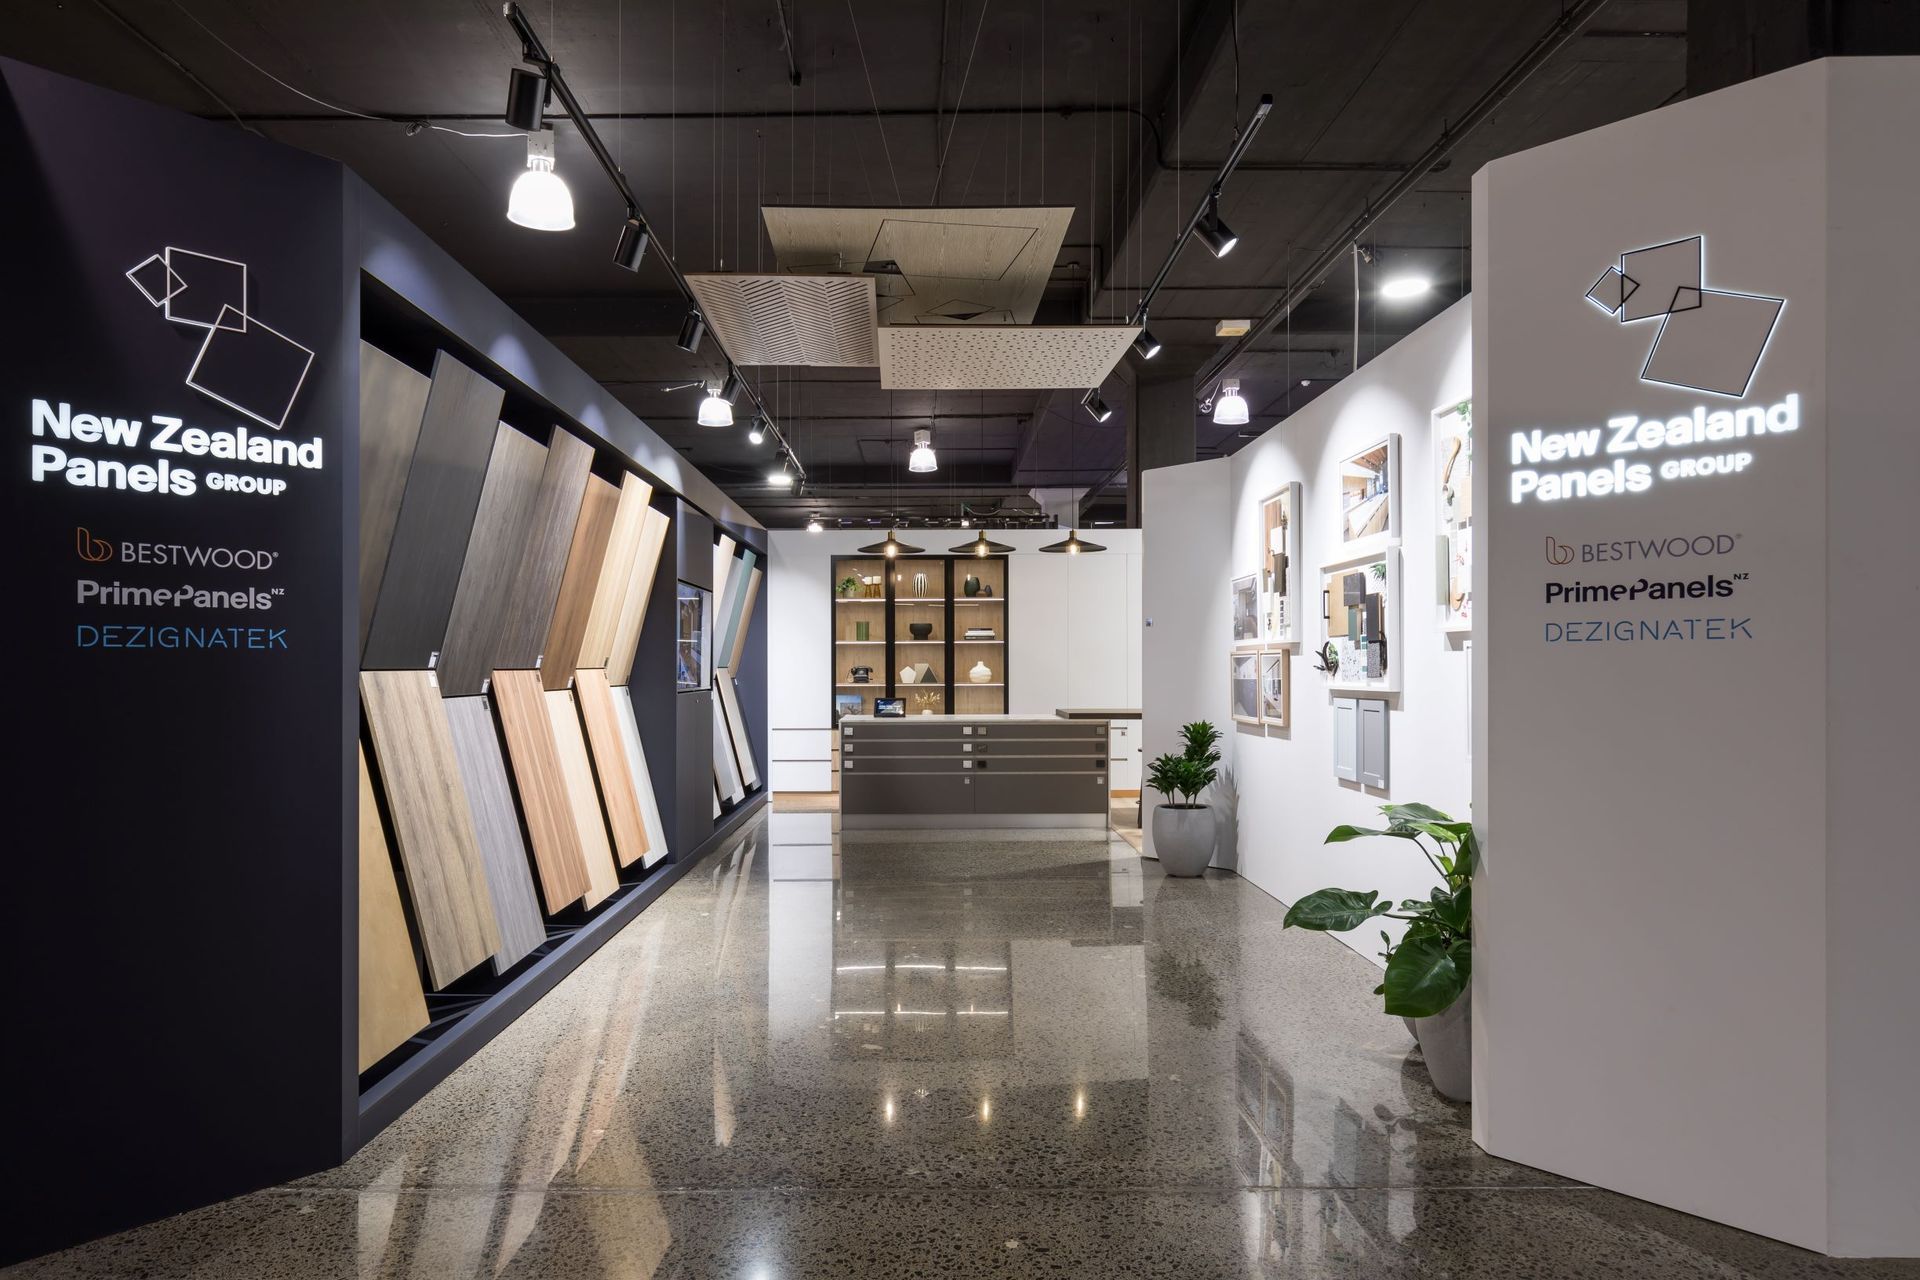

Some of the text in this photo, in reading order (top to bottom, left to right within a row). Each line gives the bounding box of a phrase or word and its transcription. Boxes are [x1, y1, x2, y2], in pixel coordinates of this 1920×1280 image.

[32, 399, 323, 469] New Zealand
[1511, 393, 1799, 465] New Zealand
[32, 445, 287, 496] Panels GROUP
[1511, 452, 1753, 504] Panels GROUP
[77, 625, 288, 649] DEZIGNATEK
[1545, 618, 1753, 642] DEZIGNATEK
